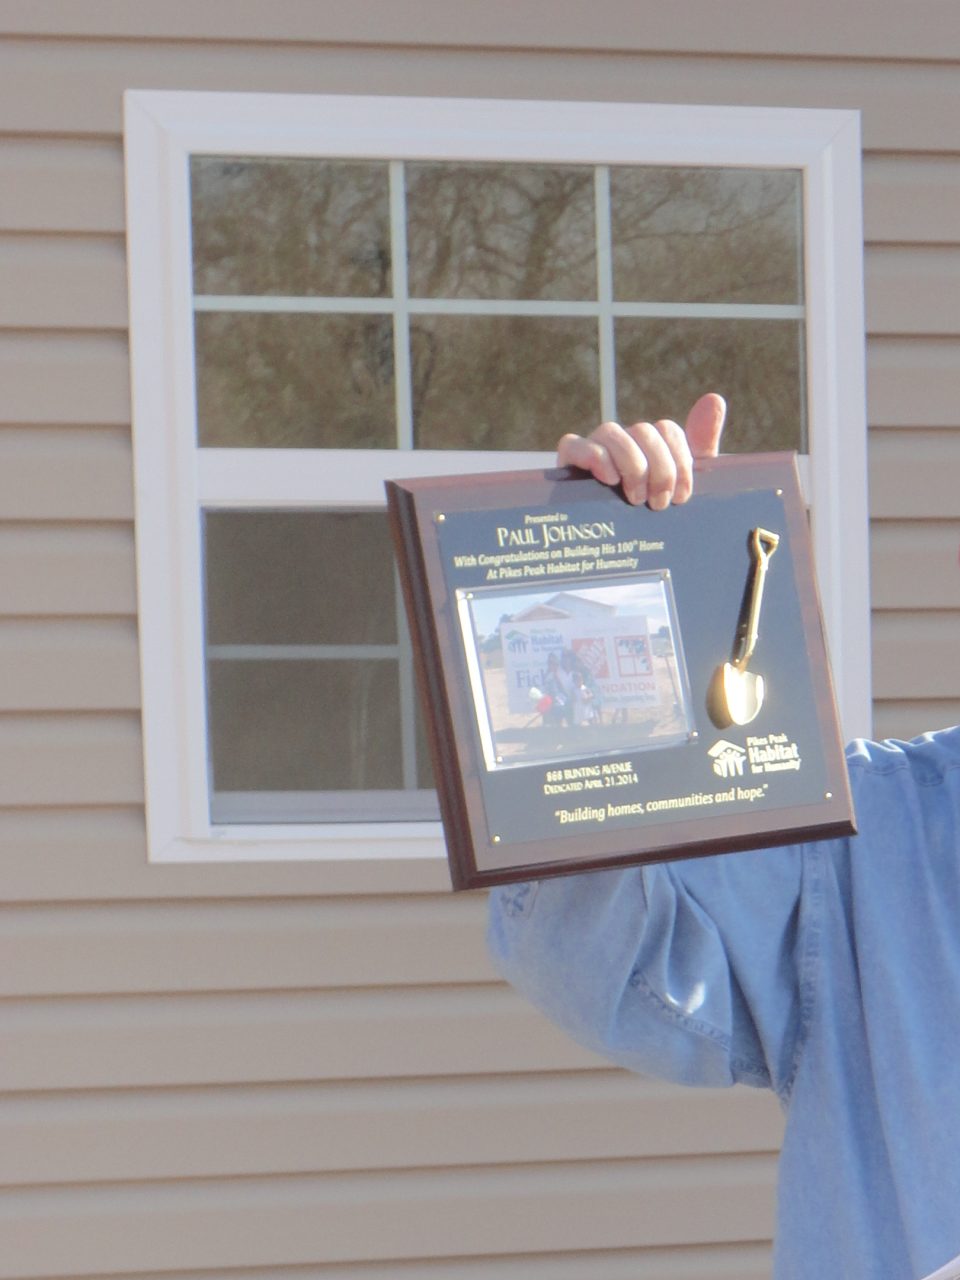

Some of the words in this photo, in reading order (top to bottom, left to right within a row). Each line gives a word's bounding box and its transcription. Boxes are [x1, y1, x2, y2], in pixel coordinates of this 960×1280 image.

[525, 514, 559, 525] Presented
[497, 526, 539, 547] PAUL
[543, 522, 616, 548] JOHNSON
[454, 554, 477, 568] With
[478, 549, 549, 567] Congratulations
[551, 549, 562, 559] on
[564, 545, 600, 559] Building
[602, 543, 615, 555] His
[640, 540, 664, 551] Home
[486, 568, 498, 580] At
[499, 565, 523, 579] Pikes
[524, 563, 545, 576] Peak
[547, 561, 580, 575] Habitat
[581, 558, 595, 574] for
[596, 557, 639, 571] Humanity
[748, 743, 800, 764] Habitat
[564, 764, 600, 780] BUNTING
[601, 761, 633, 775] AVENUE
[543, 780, 583, 795] DEDICATED
[584, 775, 604, 790] APRIL
[607, 802, 644, 817] homes,
[646, 792, 713, 812] communities
[715, 788, 735, 803] and
